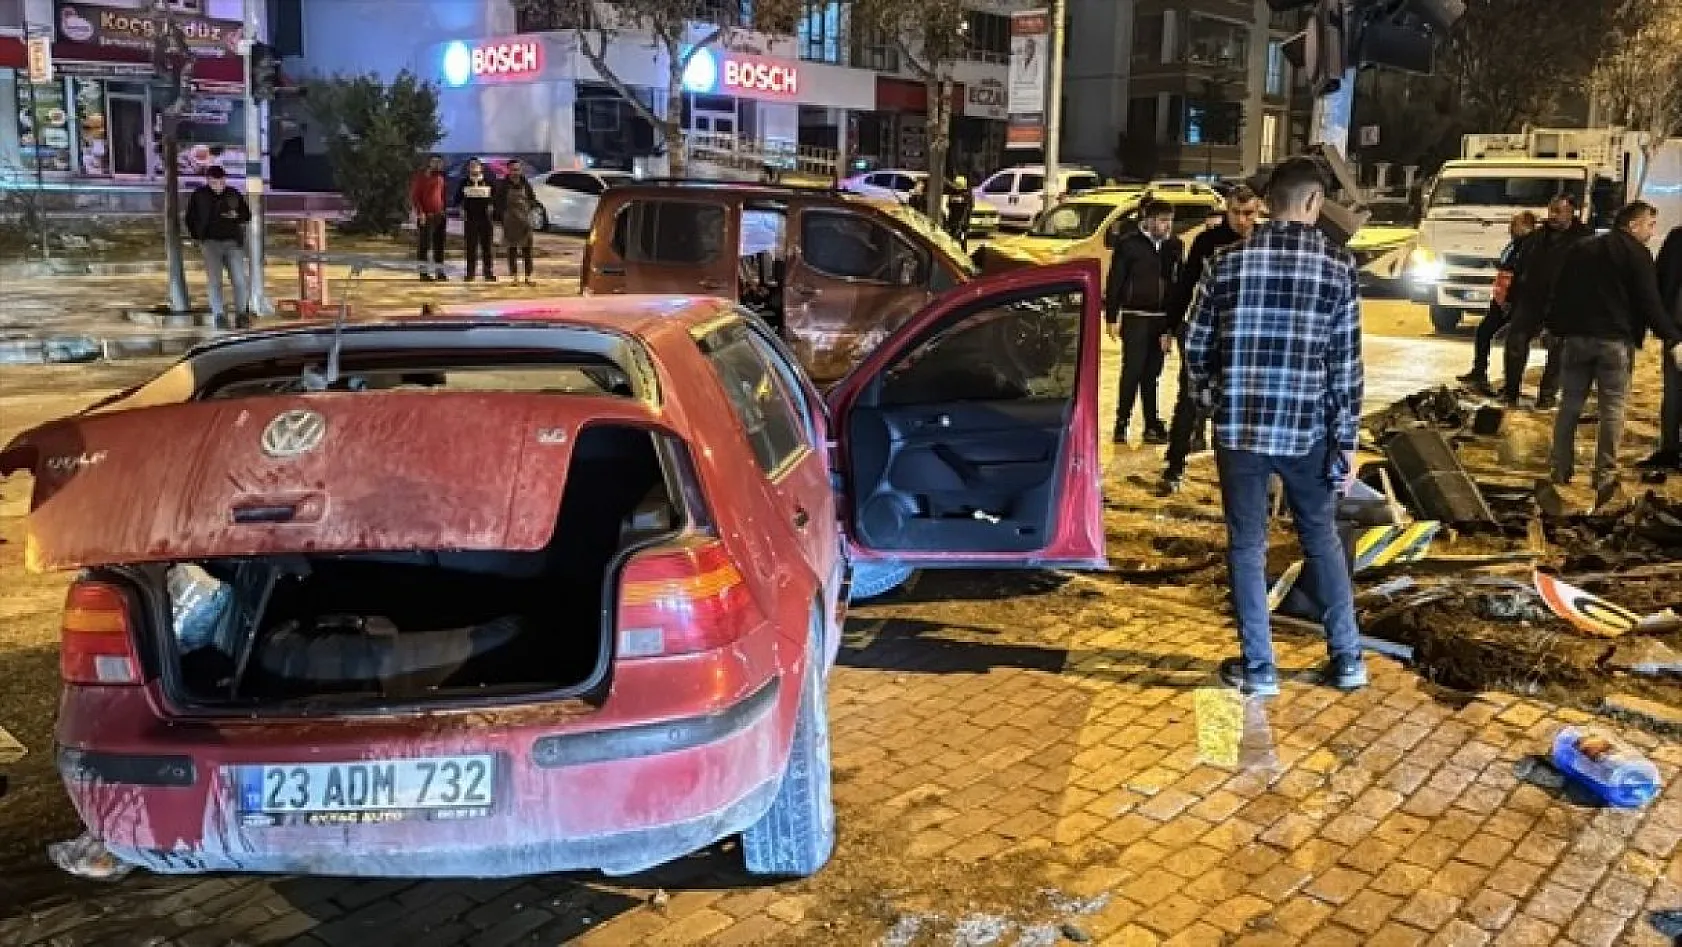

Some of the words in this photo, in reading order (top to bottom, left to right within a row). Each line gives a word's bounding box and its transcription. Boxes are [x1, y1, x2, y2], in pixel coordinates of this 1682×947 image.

[473, 42, 538, 74] BOSCH
[724, 59, 798, 93] BOSCH
[266, 767, 309, 808] 23
[321, 764, 395, 807] ADM
[416, 759, 487, 803] 732
